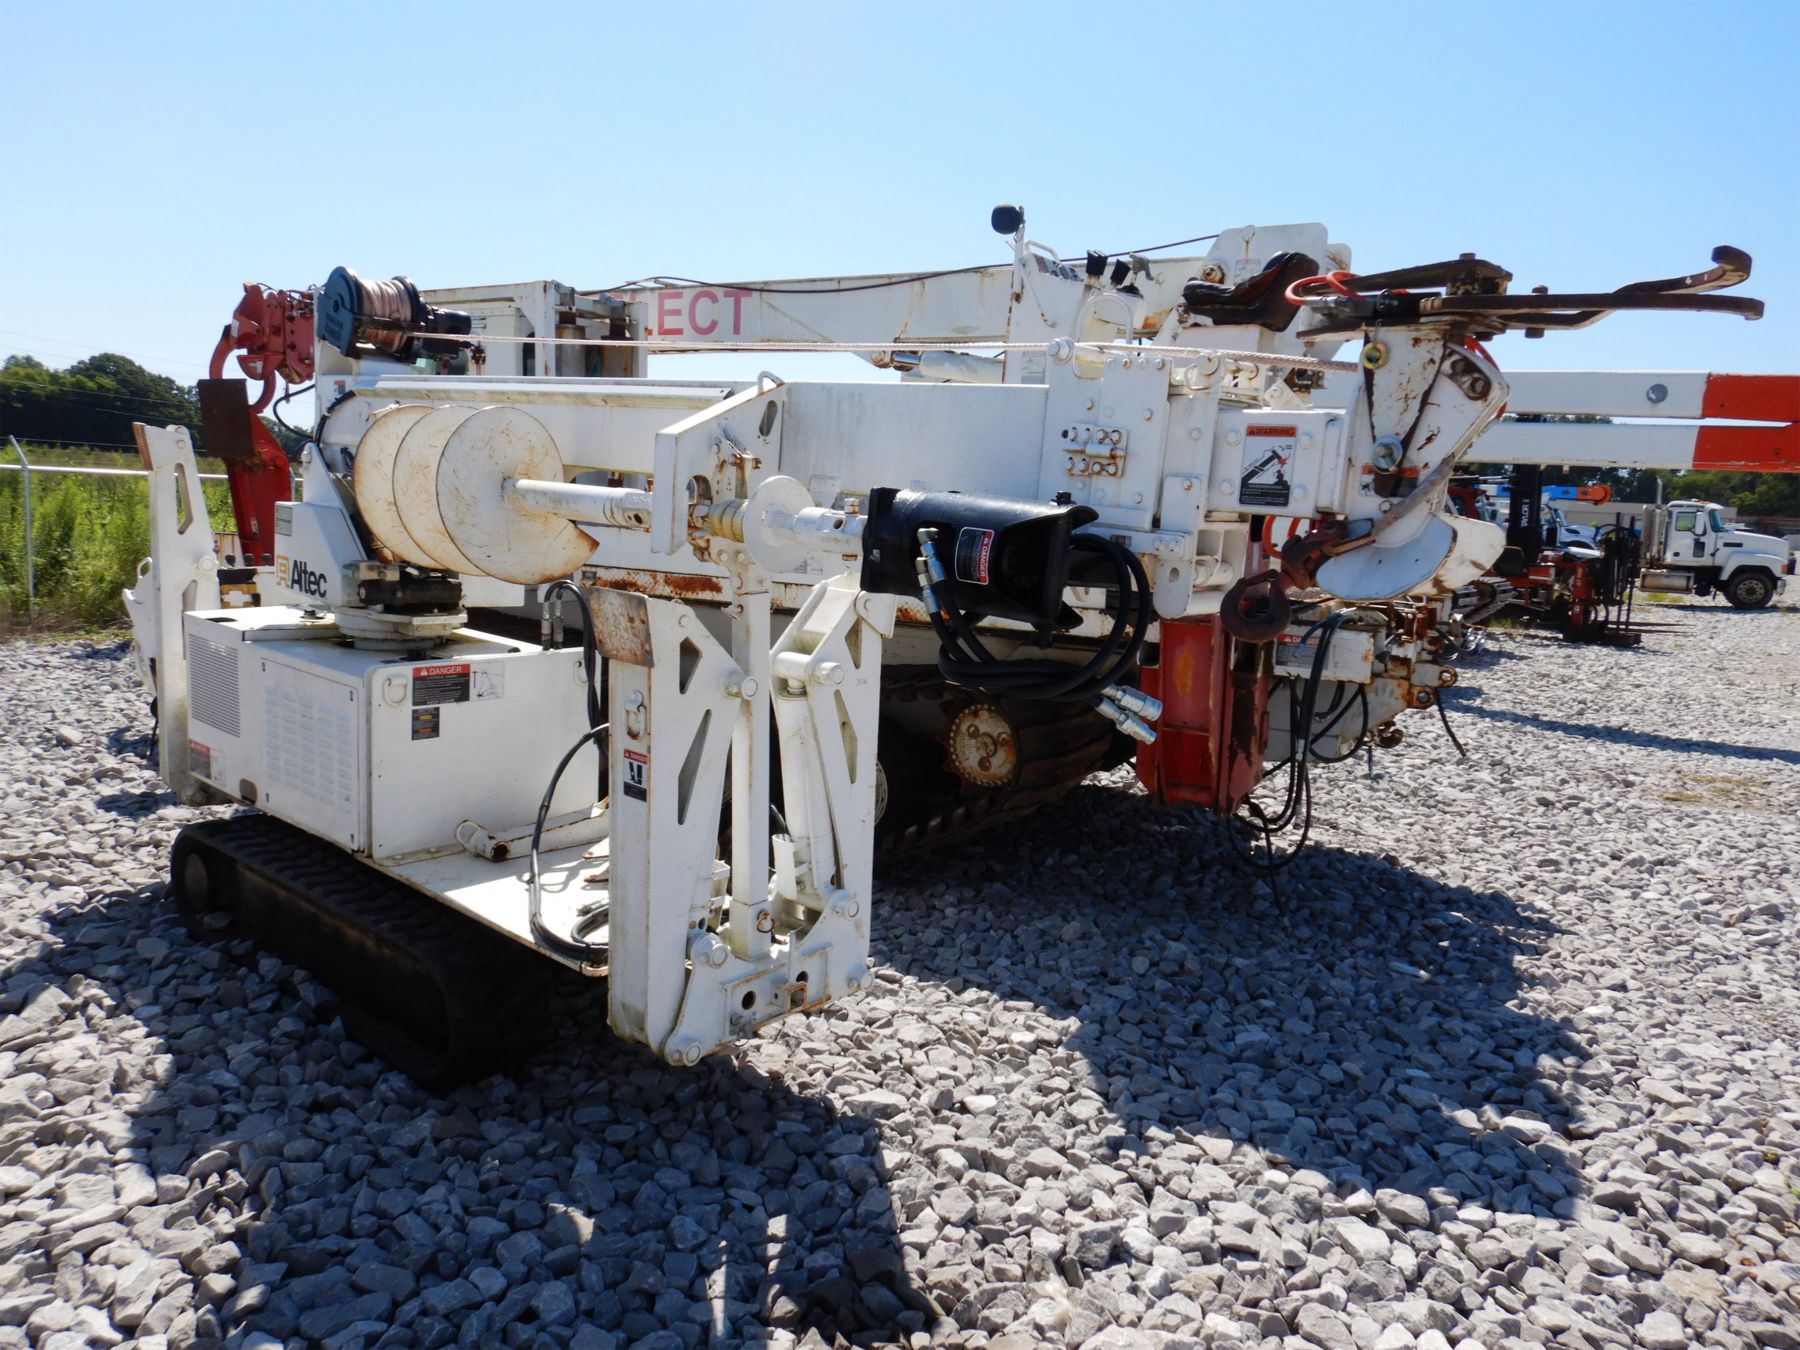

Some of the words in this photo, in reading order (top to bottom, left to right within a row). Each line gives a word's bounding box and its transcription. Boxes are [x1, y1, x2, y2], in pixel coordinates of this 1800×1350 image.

[979, 545, 988, 577] DANGER
[291, 560, 327, 598] Altec
[429, 666, 463, 675] DANGER
